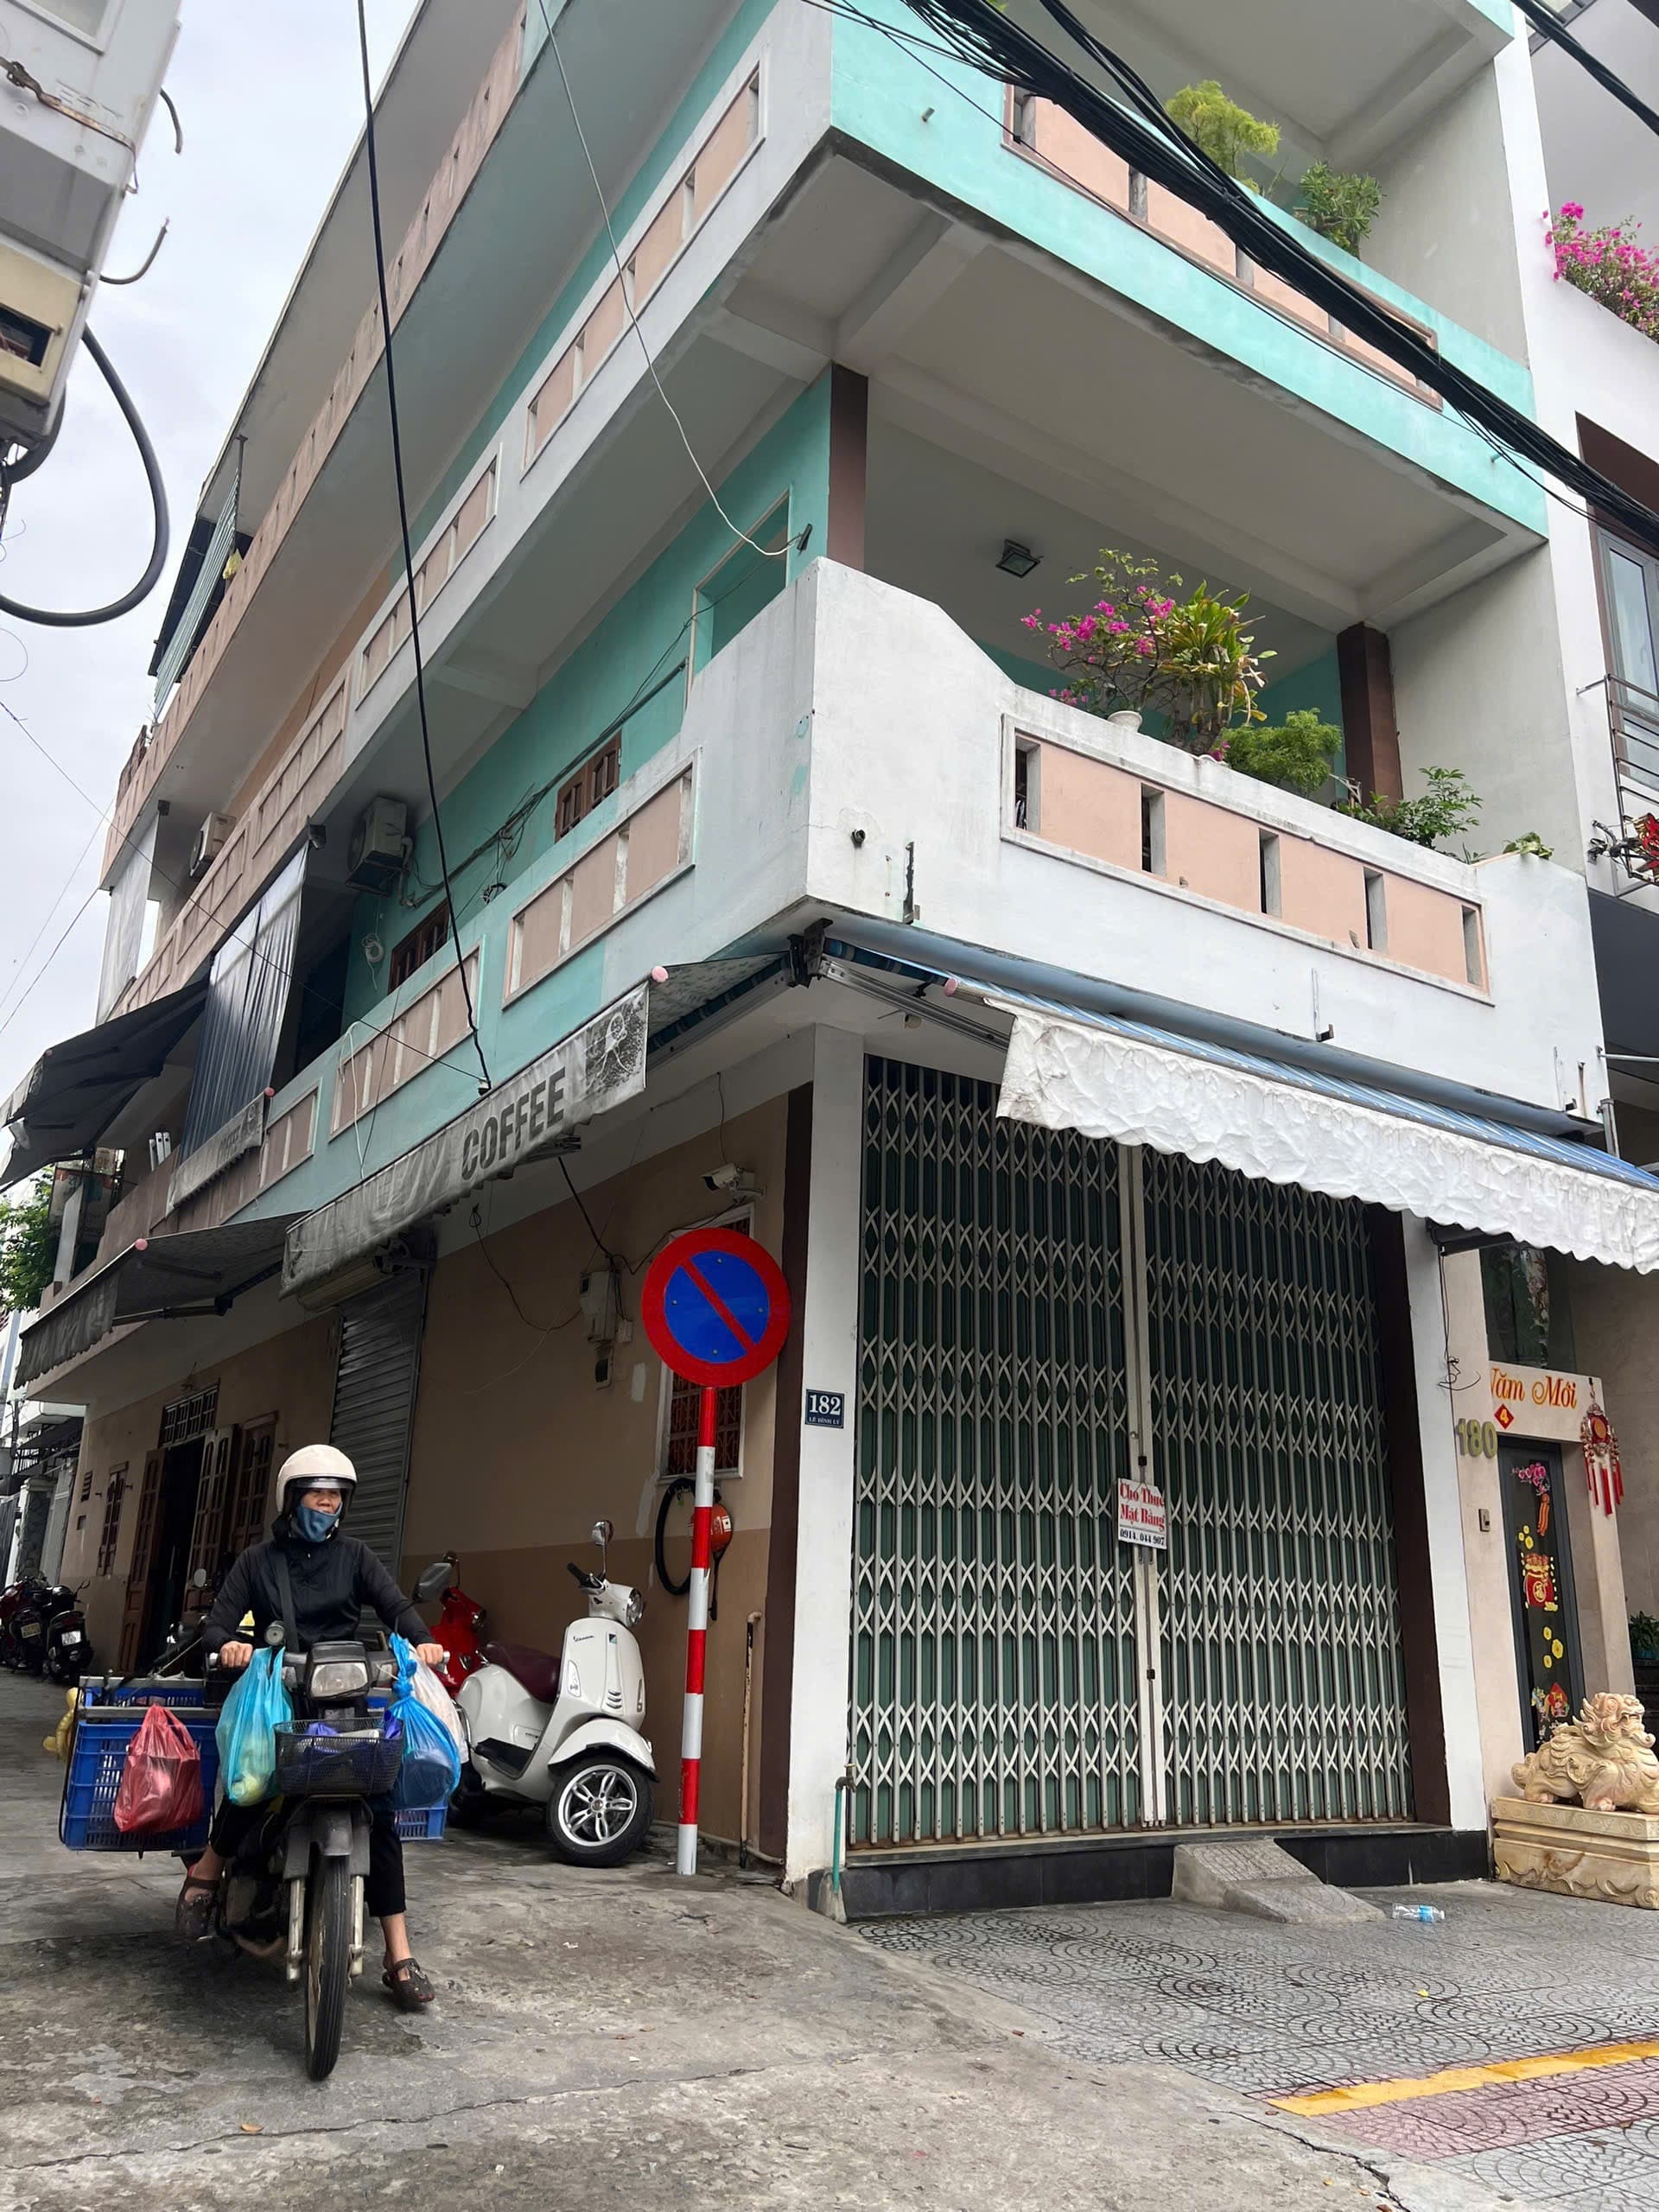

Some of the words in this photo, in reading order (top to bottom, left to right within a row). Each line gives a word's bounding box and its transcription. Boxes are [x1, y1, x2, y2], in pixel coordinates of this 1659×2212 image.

[461, 1066, 566, 1181] COFFEE
[809, 1394, 842, 1416] 182
[1532, 1375, 1577, 1409] Mới
[1499, 1408, 1510, 1424] 4
[1456, 1417, 1498, 1459] 180
[1120, 1483, 1139, 1501] Cho
